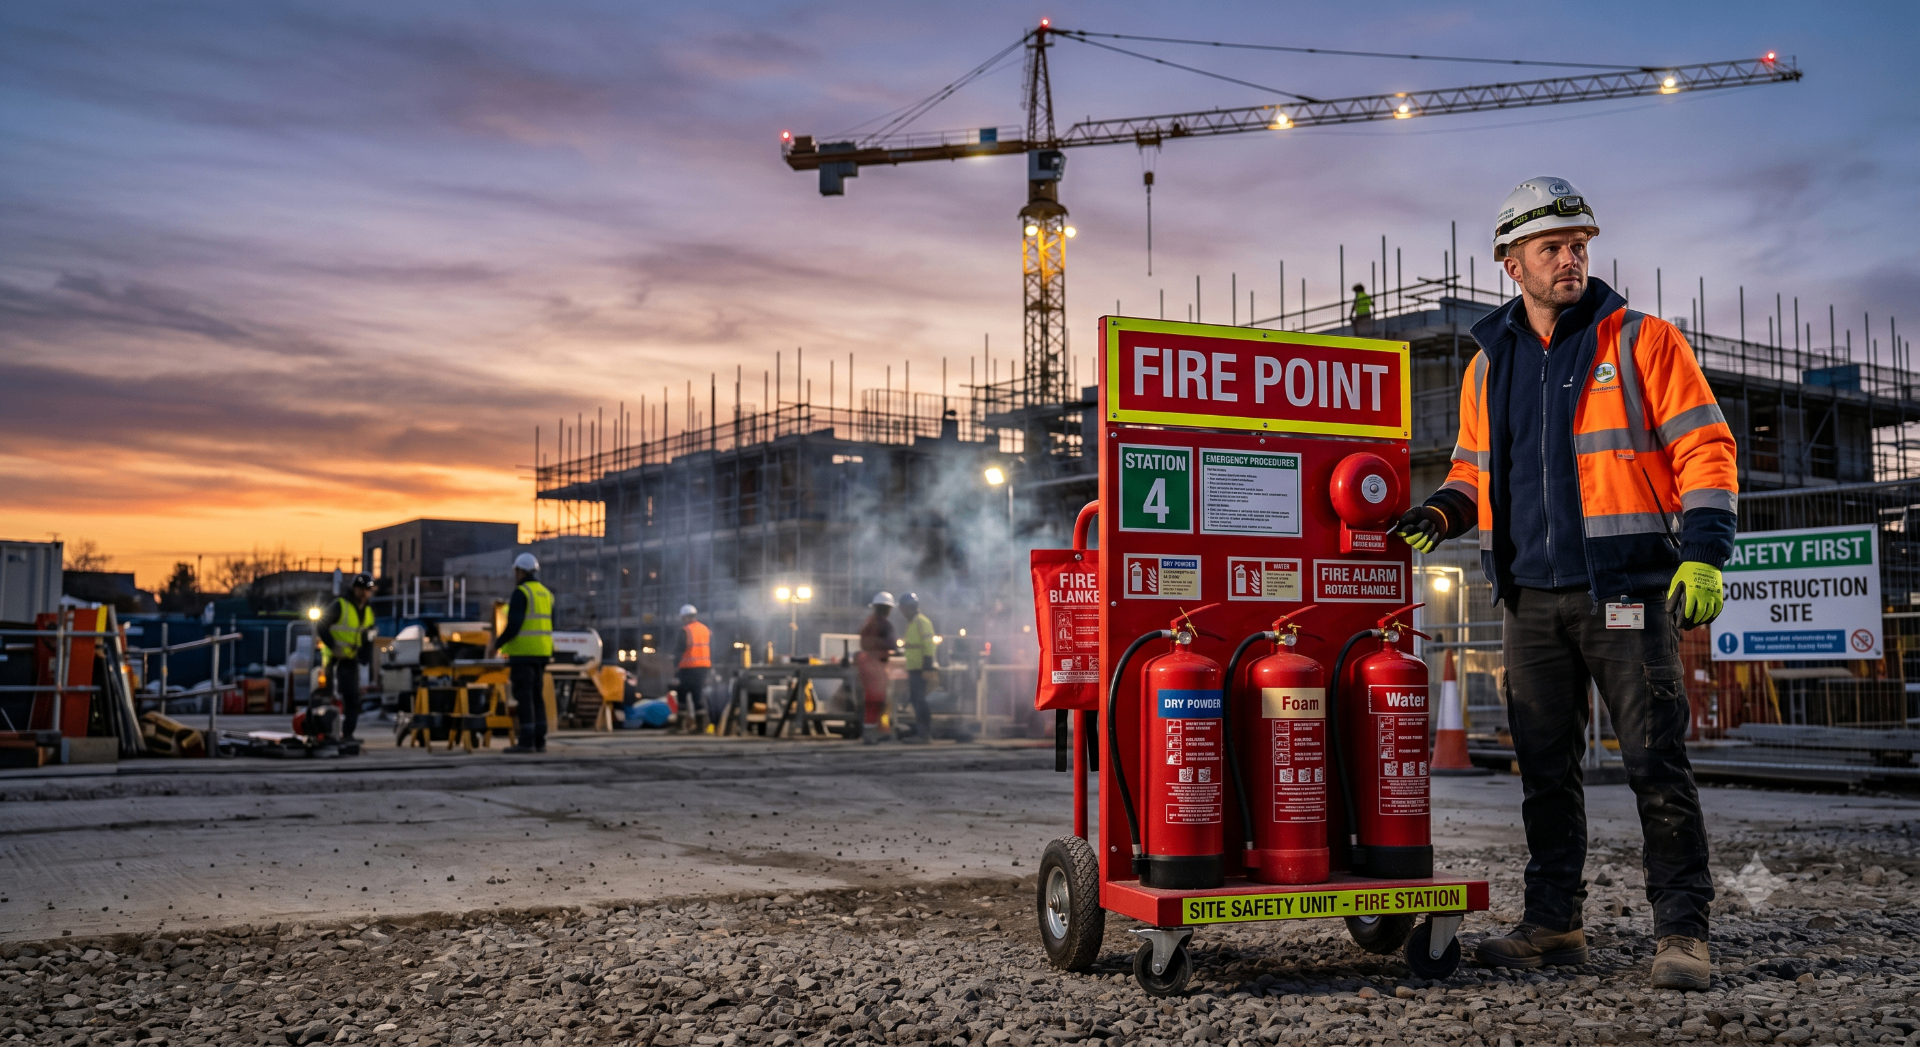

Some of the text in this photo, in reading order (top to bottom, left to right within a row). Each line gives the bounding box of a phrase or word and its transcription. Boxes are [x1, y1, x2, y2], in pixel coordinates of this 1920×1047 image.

[1134, 346, 1389, 412] FIRE POINT
[1125, 452, 1186, 471] STATION
[1206, 454, 1295, 467] EMERGENCY PROCEDURES
[1142, 477, 1170, 524] 4
[1724, 537, 1864, 566] AFETY FIRST
[1059, 572, 1097, 589] FIRE
[1321, 567, 1397, 582] FIRE ALARM
[1049, 589, 1100, 603] BLANKE
[1325, 584, 1396, 596] ROTATE HANDLE
[1770, 603, 1813, 623] SITE
[1164, 698, 1221, 709] DRY POWDER
[1282, 695, 1319, 711] Foam
[1385, 692, 1426, 707] Water
[1189, 901, 1226, 920] SITE
[1231, 897, 1295, 918] SAFETY
[1300, 895, 1338, 914] UNIT
[1355, 892, 1390, 911] FIRE
[1394, 889, 1460, 909] STATION
